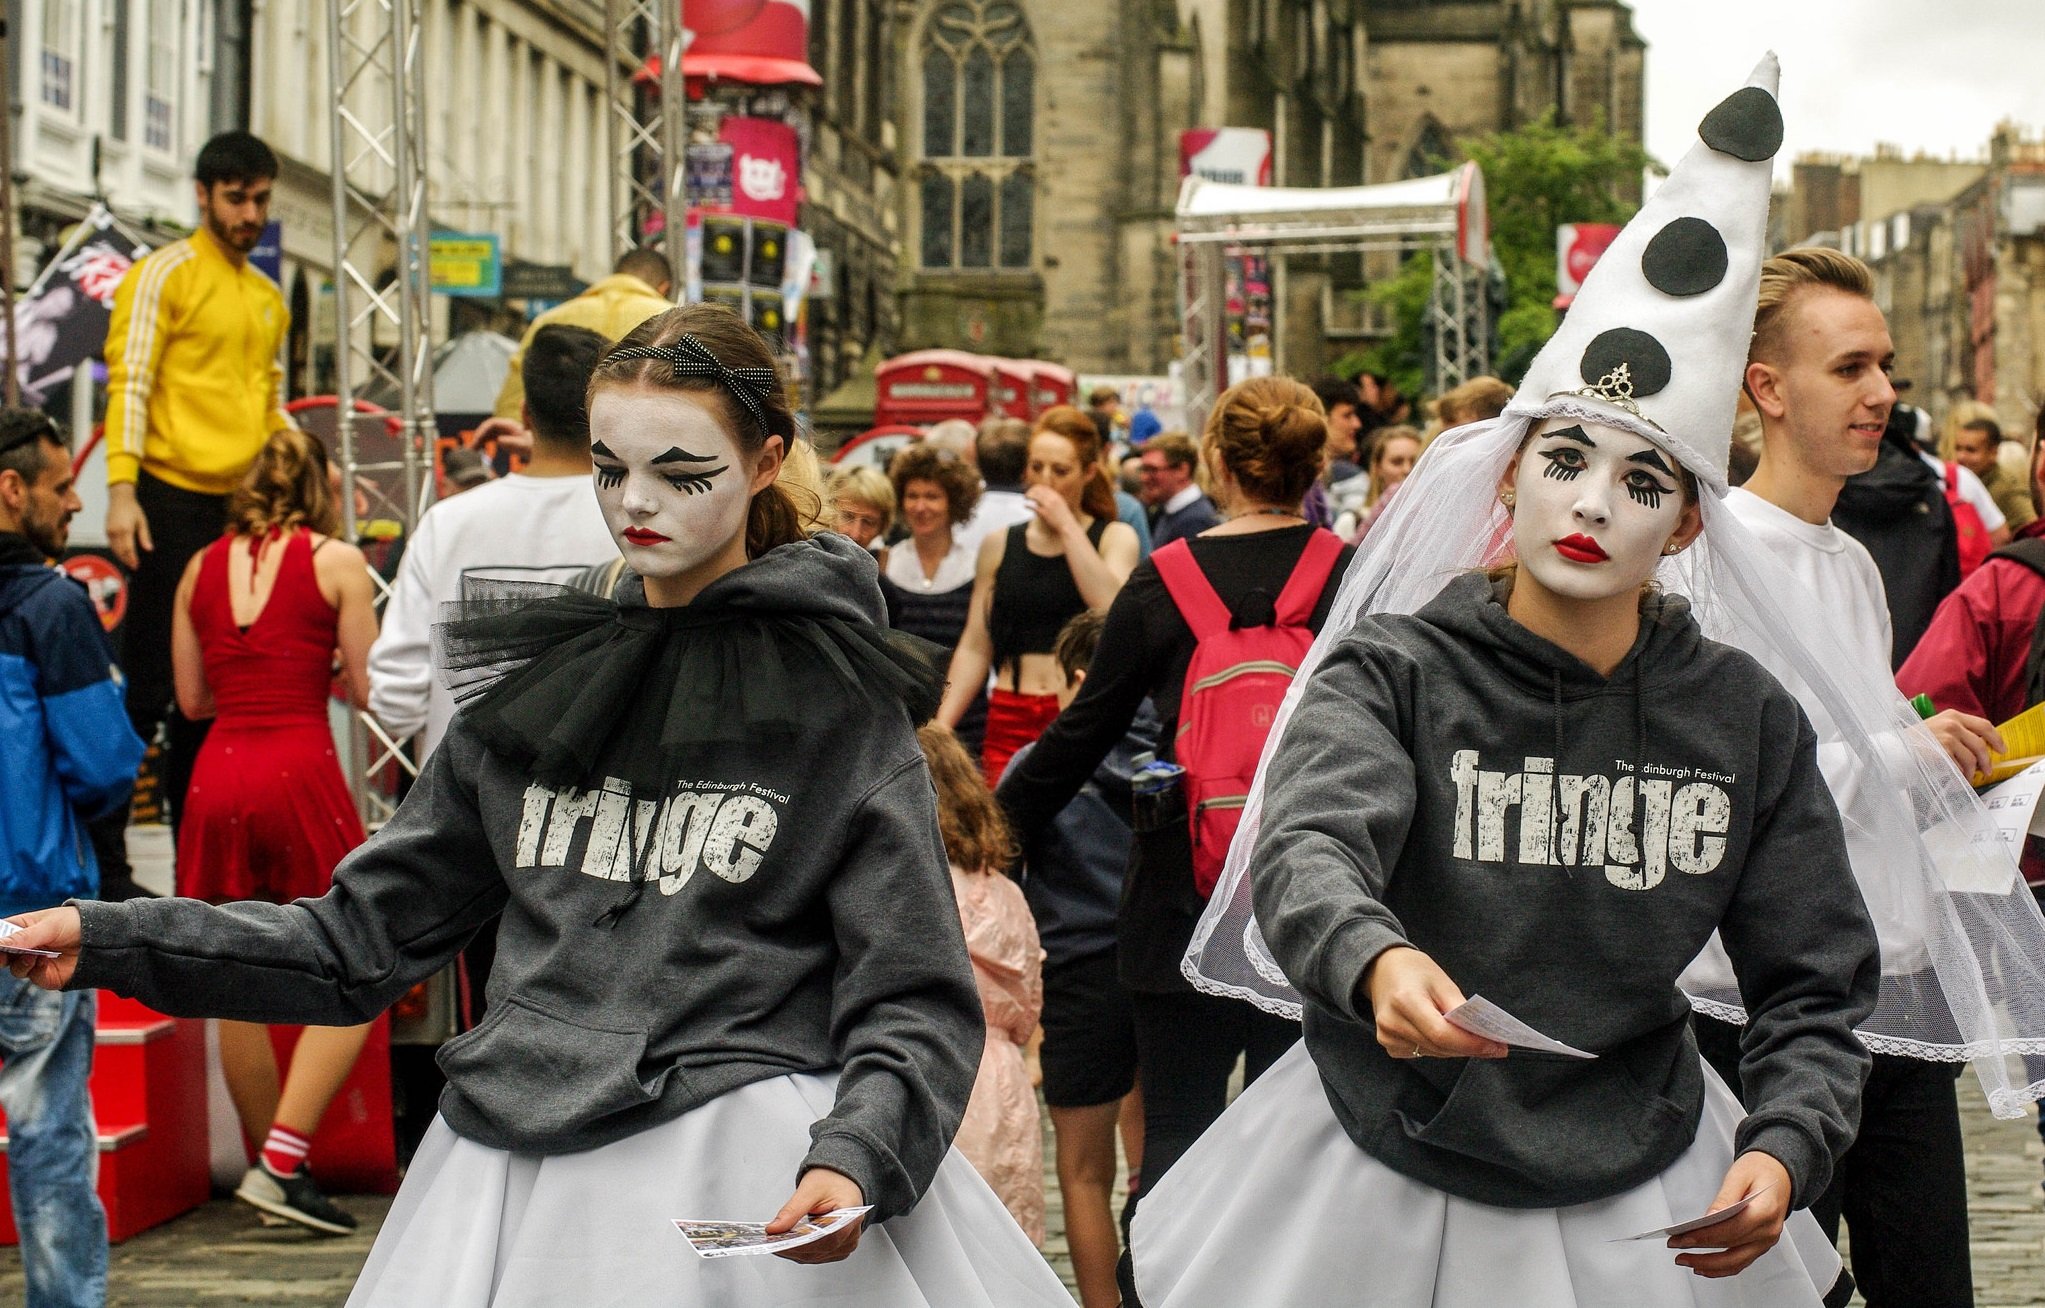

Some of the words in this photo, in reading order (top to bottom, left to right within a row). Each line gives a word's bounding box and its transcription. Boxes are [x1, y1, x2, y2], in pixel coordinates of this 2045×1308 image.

[1615, 759, 1635, 772] The
[1641, 763, 1691, 779] dinburgh
[1694, 768, 1736, 784] Festival
[677, 780, 694, 789] The
[696, 780, 746, 792] Edinburgh
[749, 782, 791, 804] Festival
[1450, 748, 1731, 891] fringe
